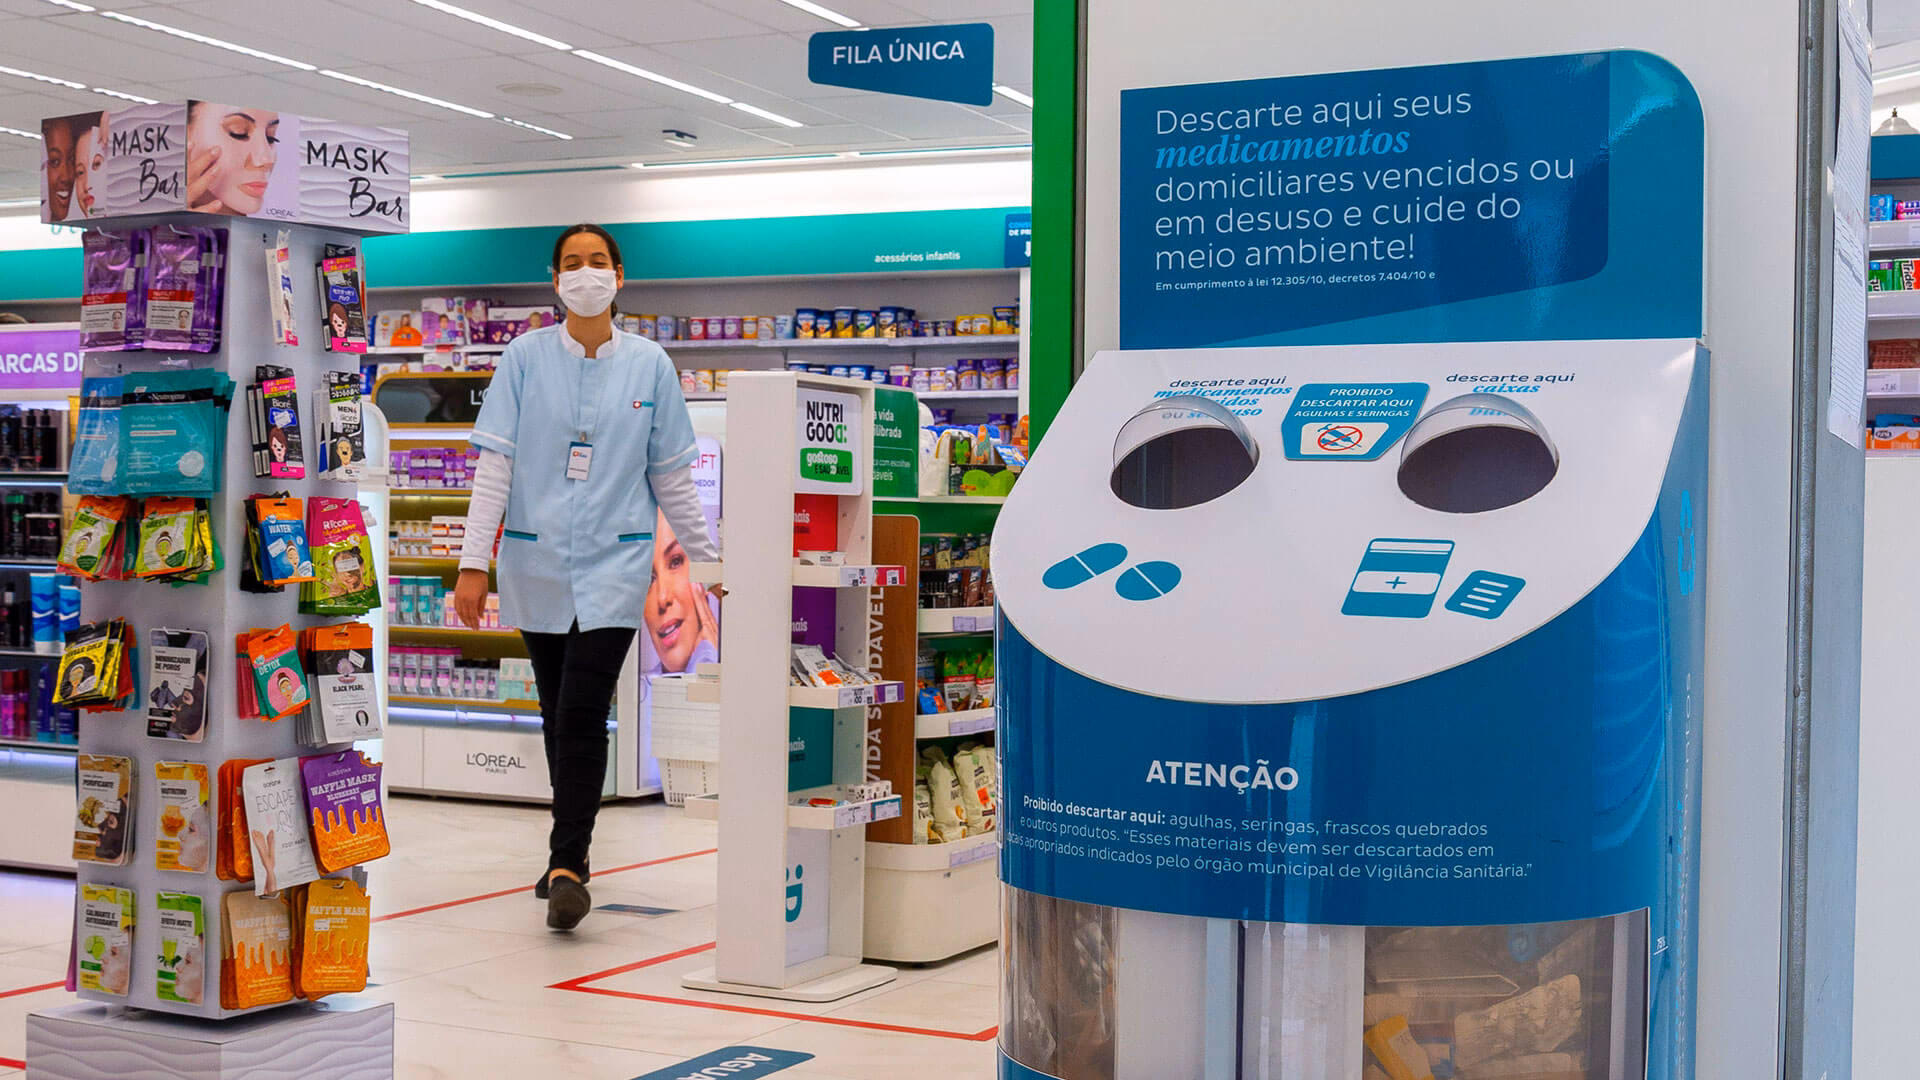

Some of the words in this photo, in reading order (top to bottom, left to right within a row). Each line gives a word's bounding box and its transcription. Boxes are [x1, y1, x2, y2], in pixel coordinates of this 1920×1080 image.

[833, 45, 883, 65] FILA
[889, 37, 965, 62] ÚNICA
[1157, 102, 1302, 135] Descarte
[1312, 93, 1381, 127] aqui
[1393, 92, 1472, 118] seus
[112, 125, 170, 156] MASK
[1155, 127, 1410, 169] medicamentos
[306, 140, 390, 175] MASK
[139, 158, 180, 202] Bar
[1155, 170, 1354, 202] domiciliares
[1363, 158, 1518, 190] vencidos
[1529, 158, 1574, 181] ou
[348, 177, 403, 222] Bar
[1155, 214, 1205, 236] em
[1215, 207, 1333, 234] desuso
[1344, 205, 1362, 227] e
[1372, 196, 1465, 225] cuide
[1476, 192, 1520, 220] do
[874, 252, 923, 263] acessórios
[926, 250, 961, 262] infantis
[1156, 242, 1235, 270] meio
[1245, 233, 1414, 266] ambiente!
[1155, 282, 1172, 291] Em
[1174, 279, 1245, 292] cumprimento
[1256, 277, 1269, 287] lei
[1271, 274, 1326, 286] 12.305/10,
[1328, 273, 1376, 284] decretos
[1378, 271, 1426, 281] 7.404/10
[0, 352, 59, 374] RCAS
[1170, 378, 1245, 388] descarte
[1248, 376, 1287, 387] aqui
[1446, 373, 1529, 382] descarte
[1533, 373, 1576, 384] aqui
[1472, 383, 1541, 393] caixas
[1153, 386, 1293, 398] medicamentos
[1300, 399, 1377, 407] DESCARTAR
[1379, 399, 1414, 407] AQUI
[1329, 388, 1394, 396] PROIBIDO
[806, 400, 844, 422] NUTRI
[878, 409, 894, 421] vida
[806, 451, 838, 466] gostoso
[268, 524, 292, 534] WATER
[322, 520, 348, 530] Ricca
[257, 658, 281, 676] DETOX
[348, 684, 365, 692] PEARL
[866, 728, 882, 782] VIDA
[310, 778, 346, 797] WAFFLE
[346, 773, 377, 788] MASK
[1145, 758, 1299, 795] ATENÇÃO
[255, 788, 297, 813] ESCAPE
[1023, 795, 1064, 813] Proibido
[1066, 802, 1127, 821] descartar
[1129, 810, 1166, 826] aqui:
[1169, 814, 1237, 832] agulhas,
[1241, 818, 1319, 836] seringas,
[1325, 820, 1390, 836] frascos
[1395, 822, 1488, 838] quebrados
[1020, 816, 1025, 826] e
[1026, 818, 1058, 833] outros
[1059, 824, 1120, 842] produtos.
[1175, 835, 1252, 851] materiais
[1256, 839, 1317, 855] devem
[1321, 844, 1350, 856] ser
[1354, 843, 1464, 857] descartados
[1467, 845, 1494, 857] em
[1025, 836, 1085, 857] apropriados
[1088, 846, 1152, 865] indicados
[1156, 854, 1190, 869] pelo
[1194, 856, 1243, 874] órgão
[1248, 861, 1334, 879] municipal
[1338, 864, 1361, 877] de
[1365, 864, 1449, 881] Vigilância
